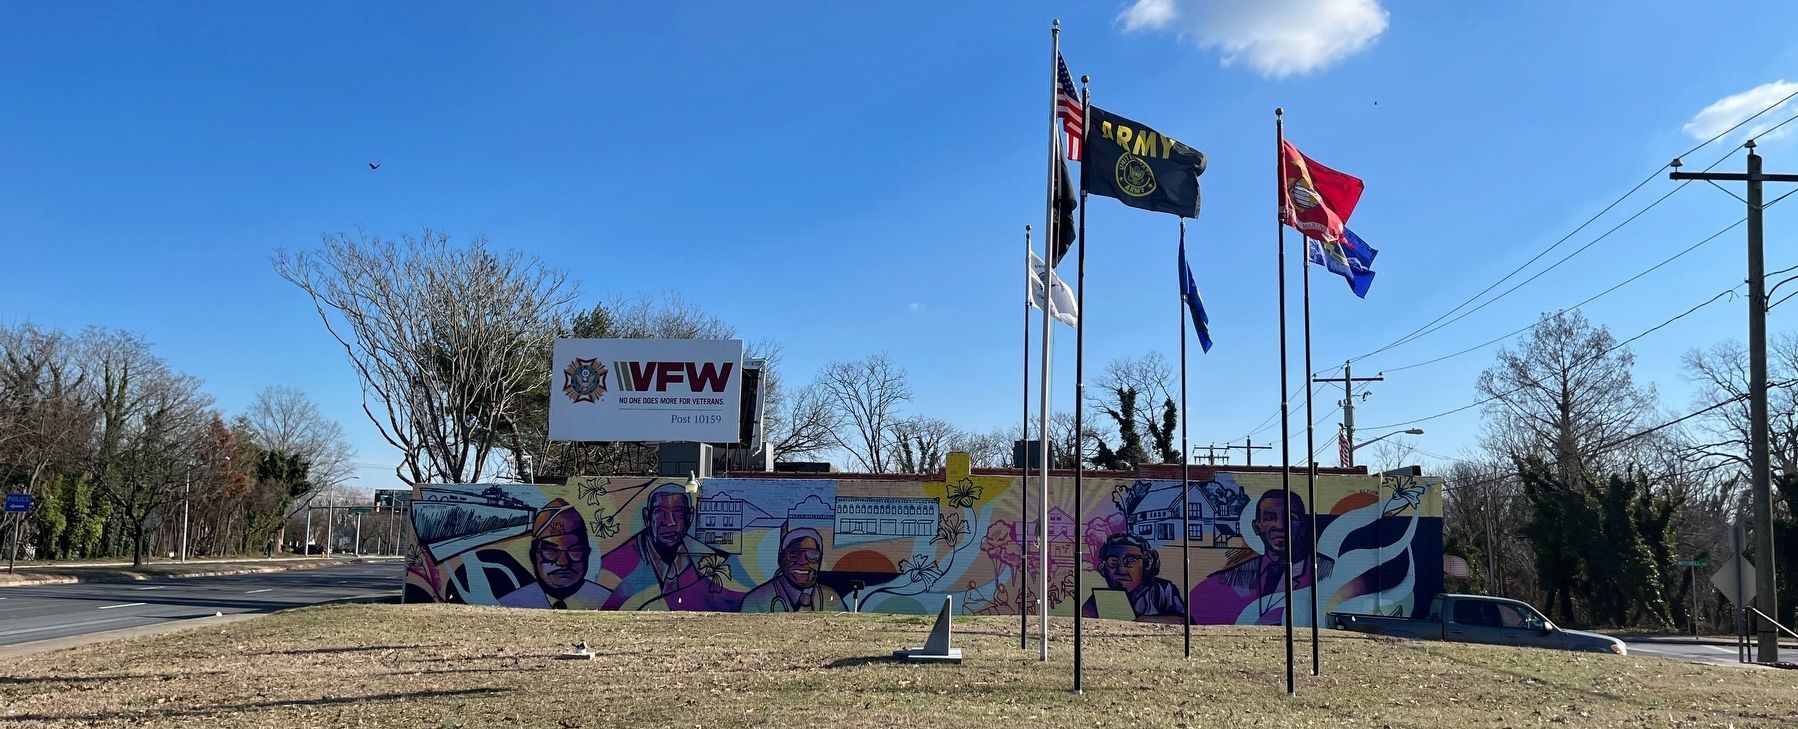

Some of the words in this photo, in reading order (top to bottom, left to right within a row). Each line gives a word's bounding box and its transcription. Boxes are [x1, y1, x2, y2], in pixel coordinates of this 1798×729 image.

[1102, 120, 1176, 159] ARMY
[629, 361, 734, 393] VFW
[643, 397, 659, 405] DOES
[660, 397, 677, 405] MORE
[671, 414, 691, 424] Post
[694, 415, 722, 424] 10159
